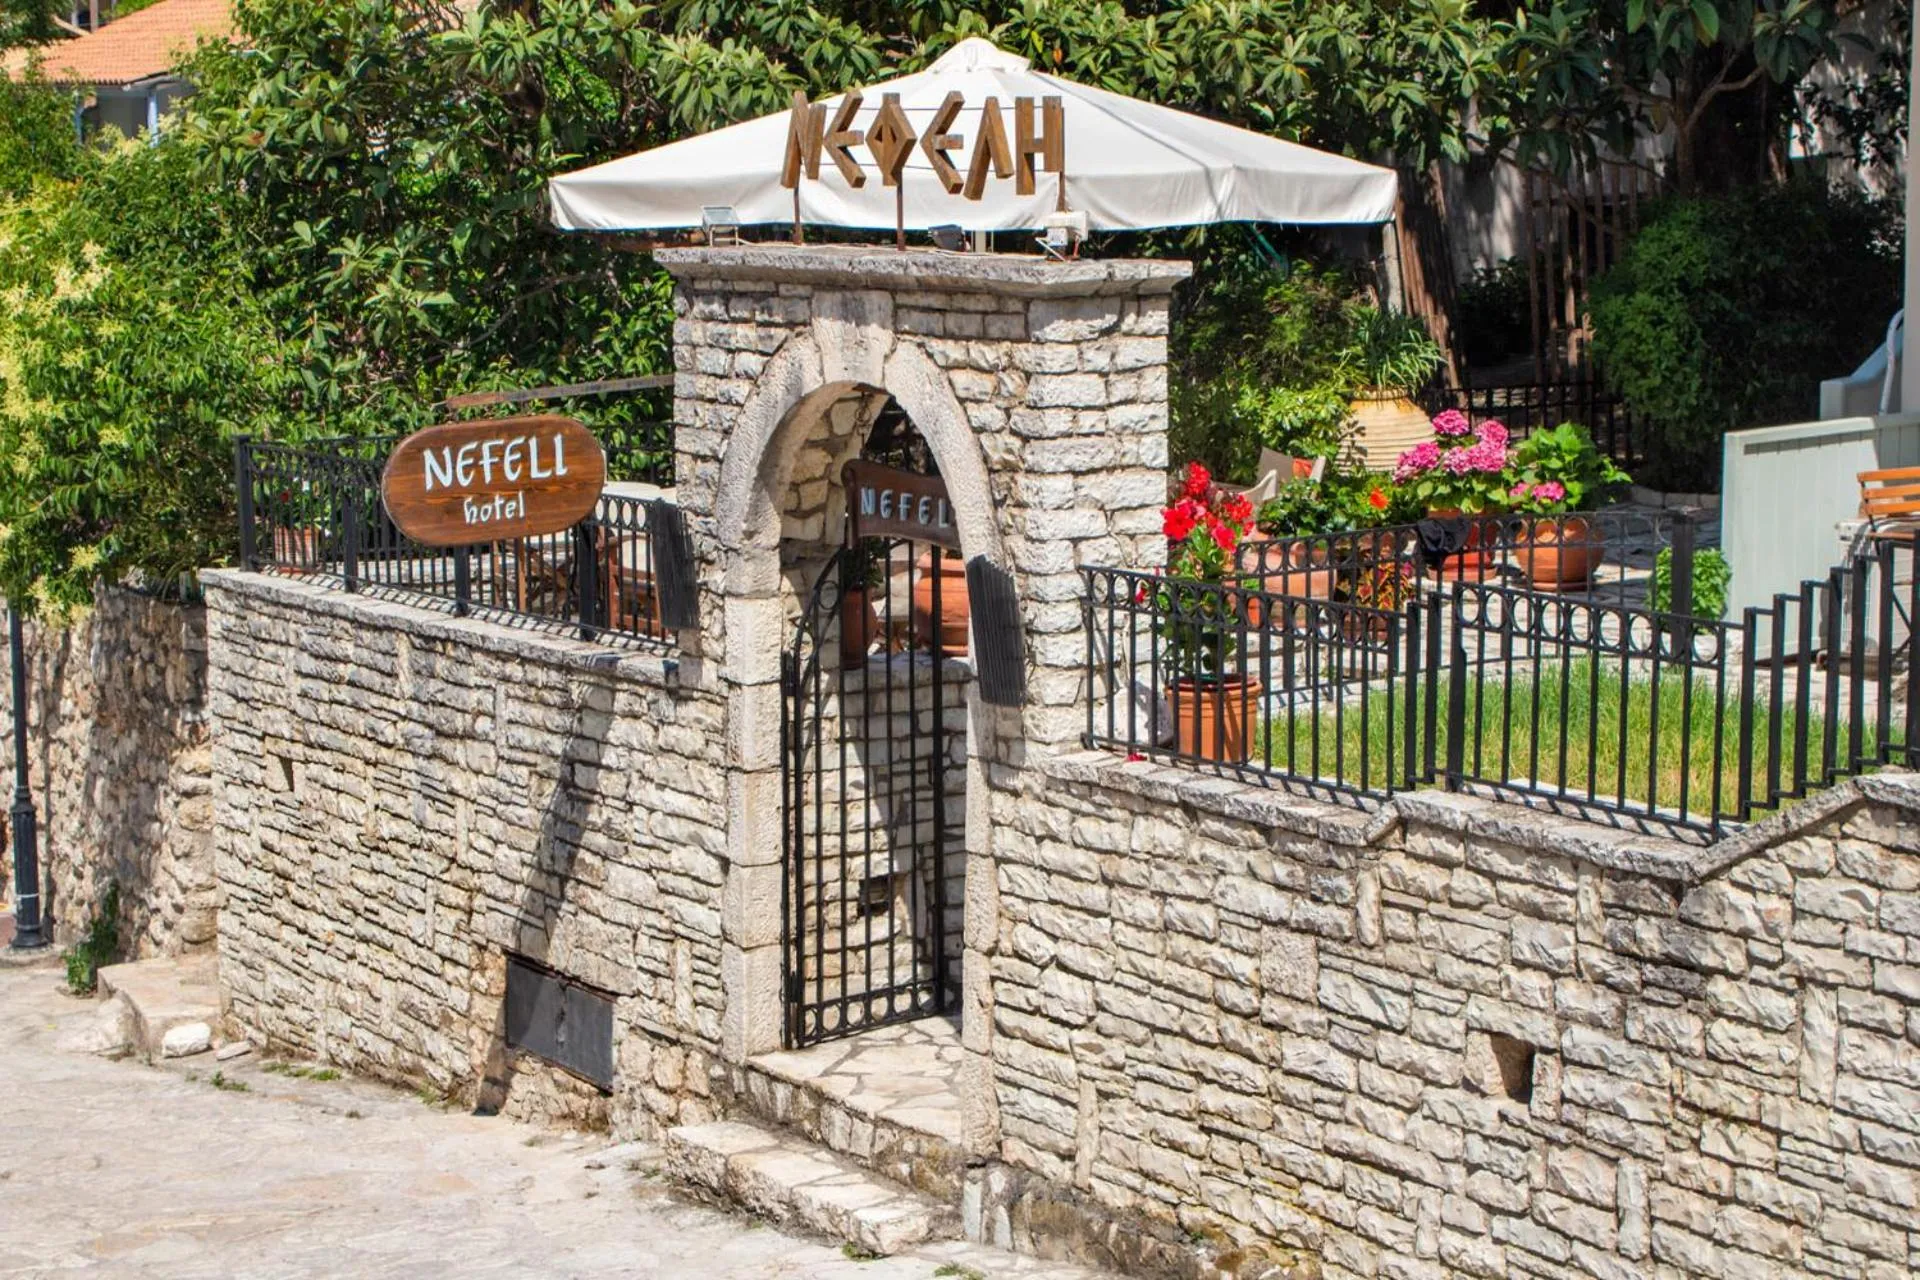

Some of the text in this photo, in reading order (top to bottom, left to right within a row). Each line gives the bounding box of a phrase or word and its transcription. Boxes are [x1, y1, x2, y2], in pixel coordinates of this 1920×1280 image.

[780, 90, 1064, 200] ΝΕΦΕΛΗ
[423, 433, 568, 492] NEFELI
[463, 490, 526, 524] hotel
[860, 486, 949, 528] NEFEL
